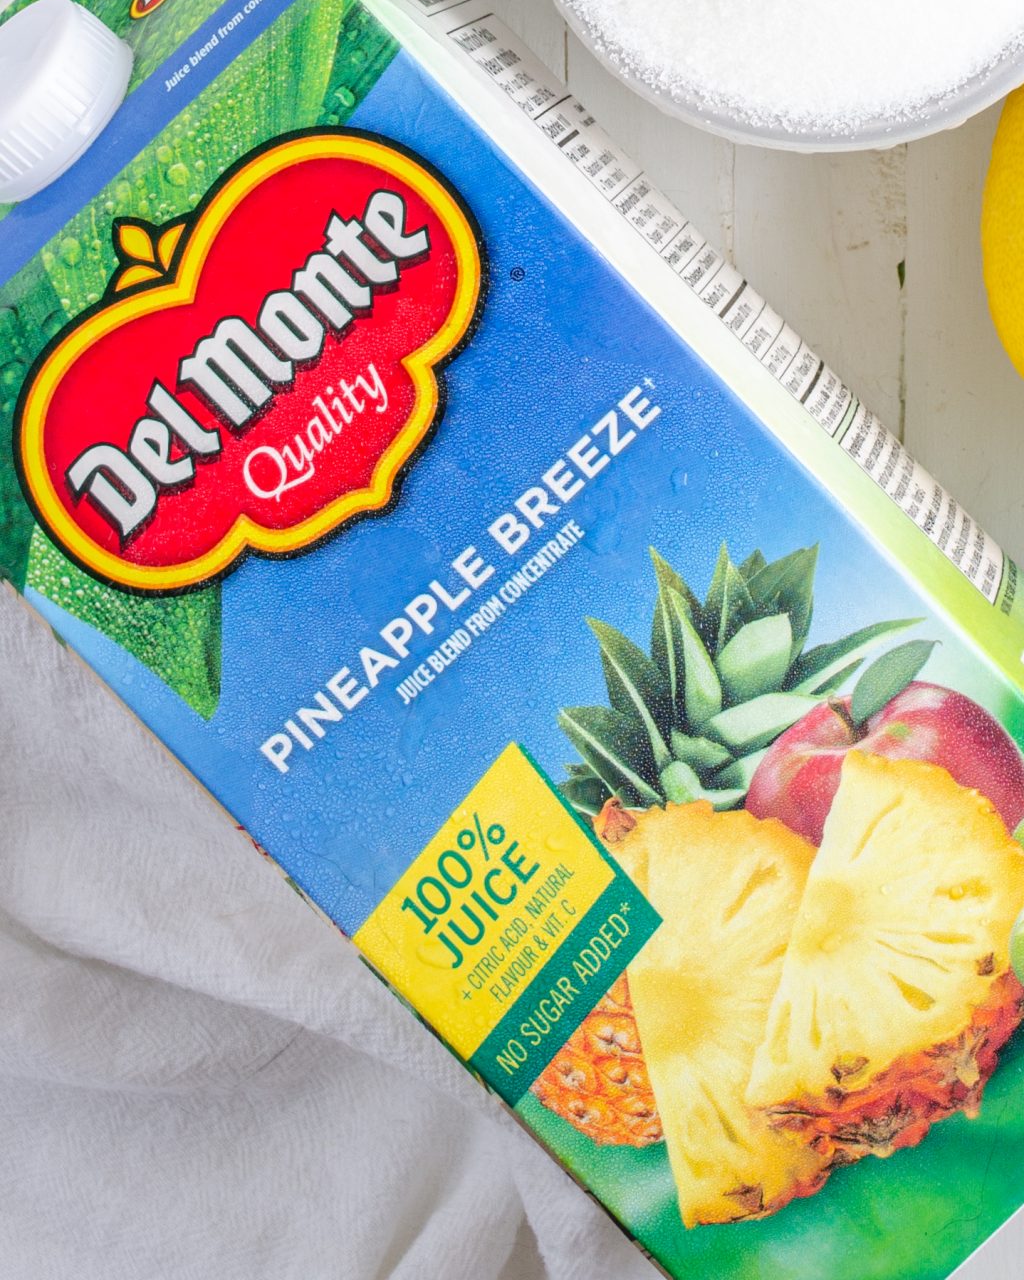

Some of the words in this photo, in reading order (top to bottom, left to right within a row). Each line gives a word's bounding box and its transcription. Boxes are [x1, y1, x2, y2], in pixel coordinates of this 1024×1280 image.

[164, 65, 190, 93] Juice
[188, 34, 220, 67] blend
[217, 13, 245, 41] from
[66, 377, 223, 552] Del
[177, 188, 432, 438] Monte
[242, 360, 389, 503] Quality
[259, 546, 496, 775] PINEAPPLE
[395, 667, 436, 705] JUICE
[429, 628, 472, 676] BLEND
[466, 595, 508, 643] FROM
[500, 519, 586, 603] CONCENTRATE
[401, 811, 506, 936] 100%
[437, 840, 541, 970] JUICE
[467, 946, 506, 992] CITRIC
[500, 914, 533, 953] ACID,
[524, 862, 576, 921] NATURAL
[543, 911, 568, 941] VIT.
[565, 898, 578, 917] C
[489, 945, 540, 1004] FLAVOUR
[537, 935, 550, 953] &
[495, 1038, 529, 1077] NO
[520, 976, 581, 1046] SUGAR
